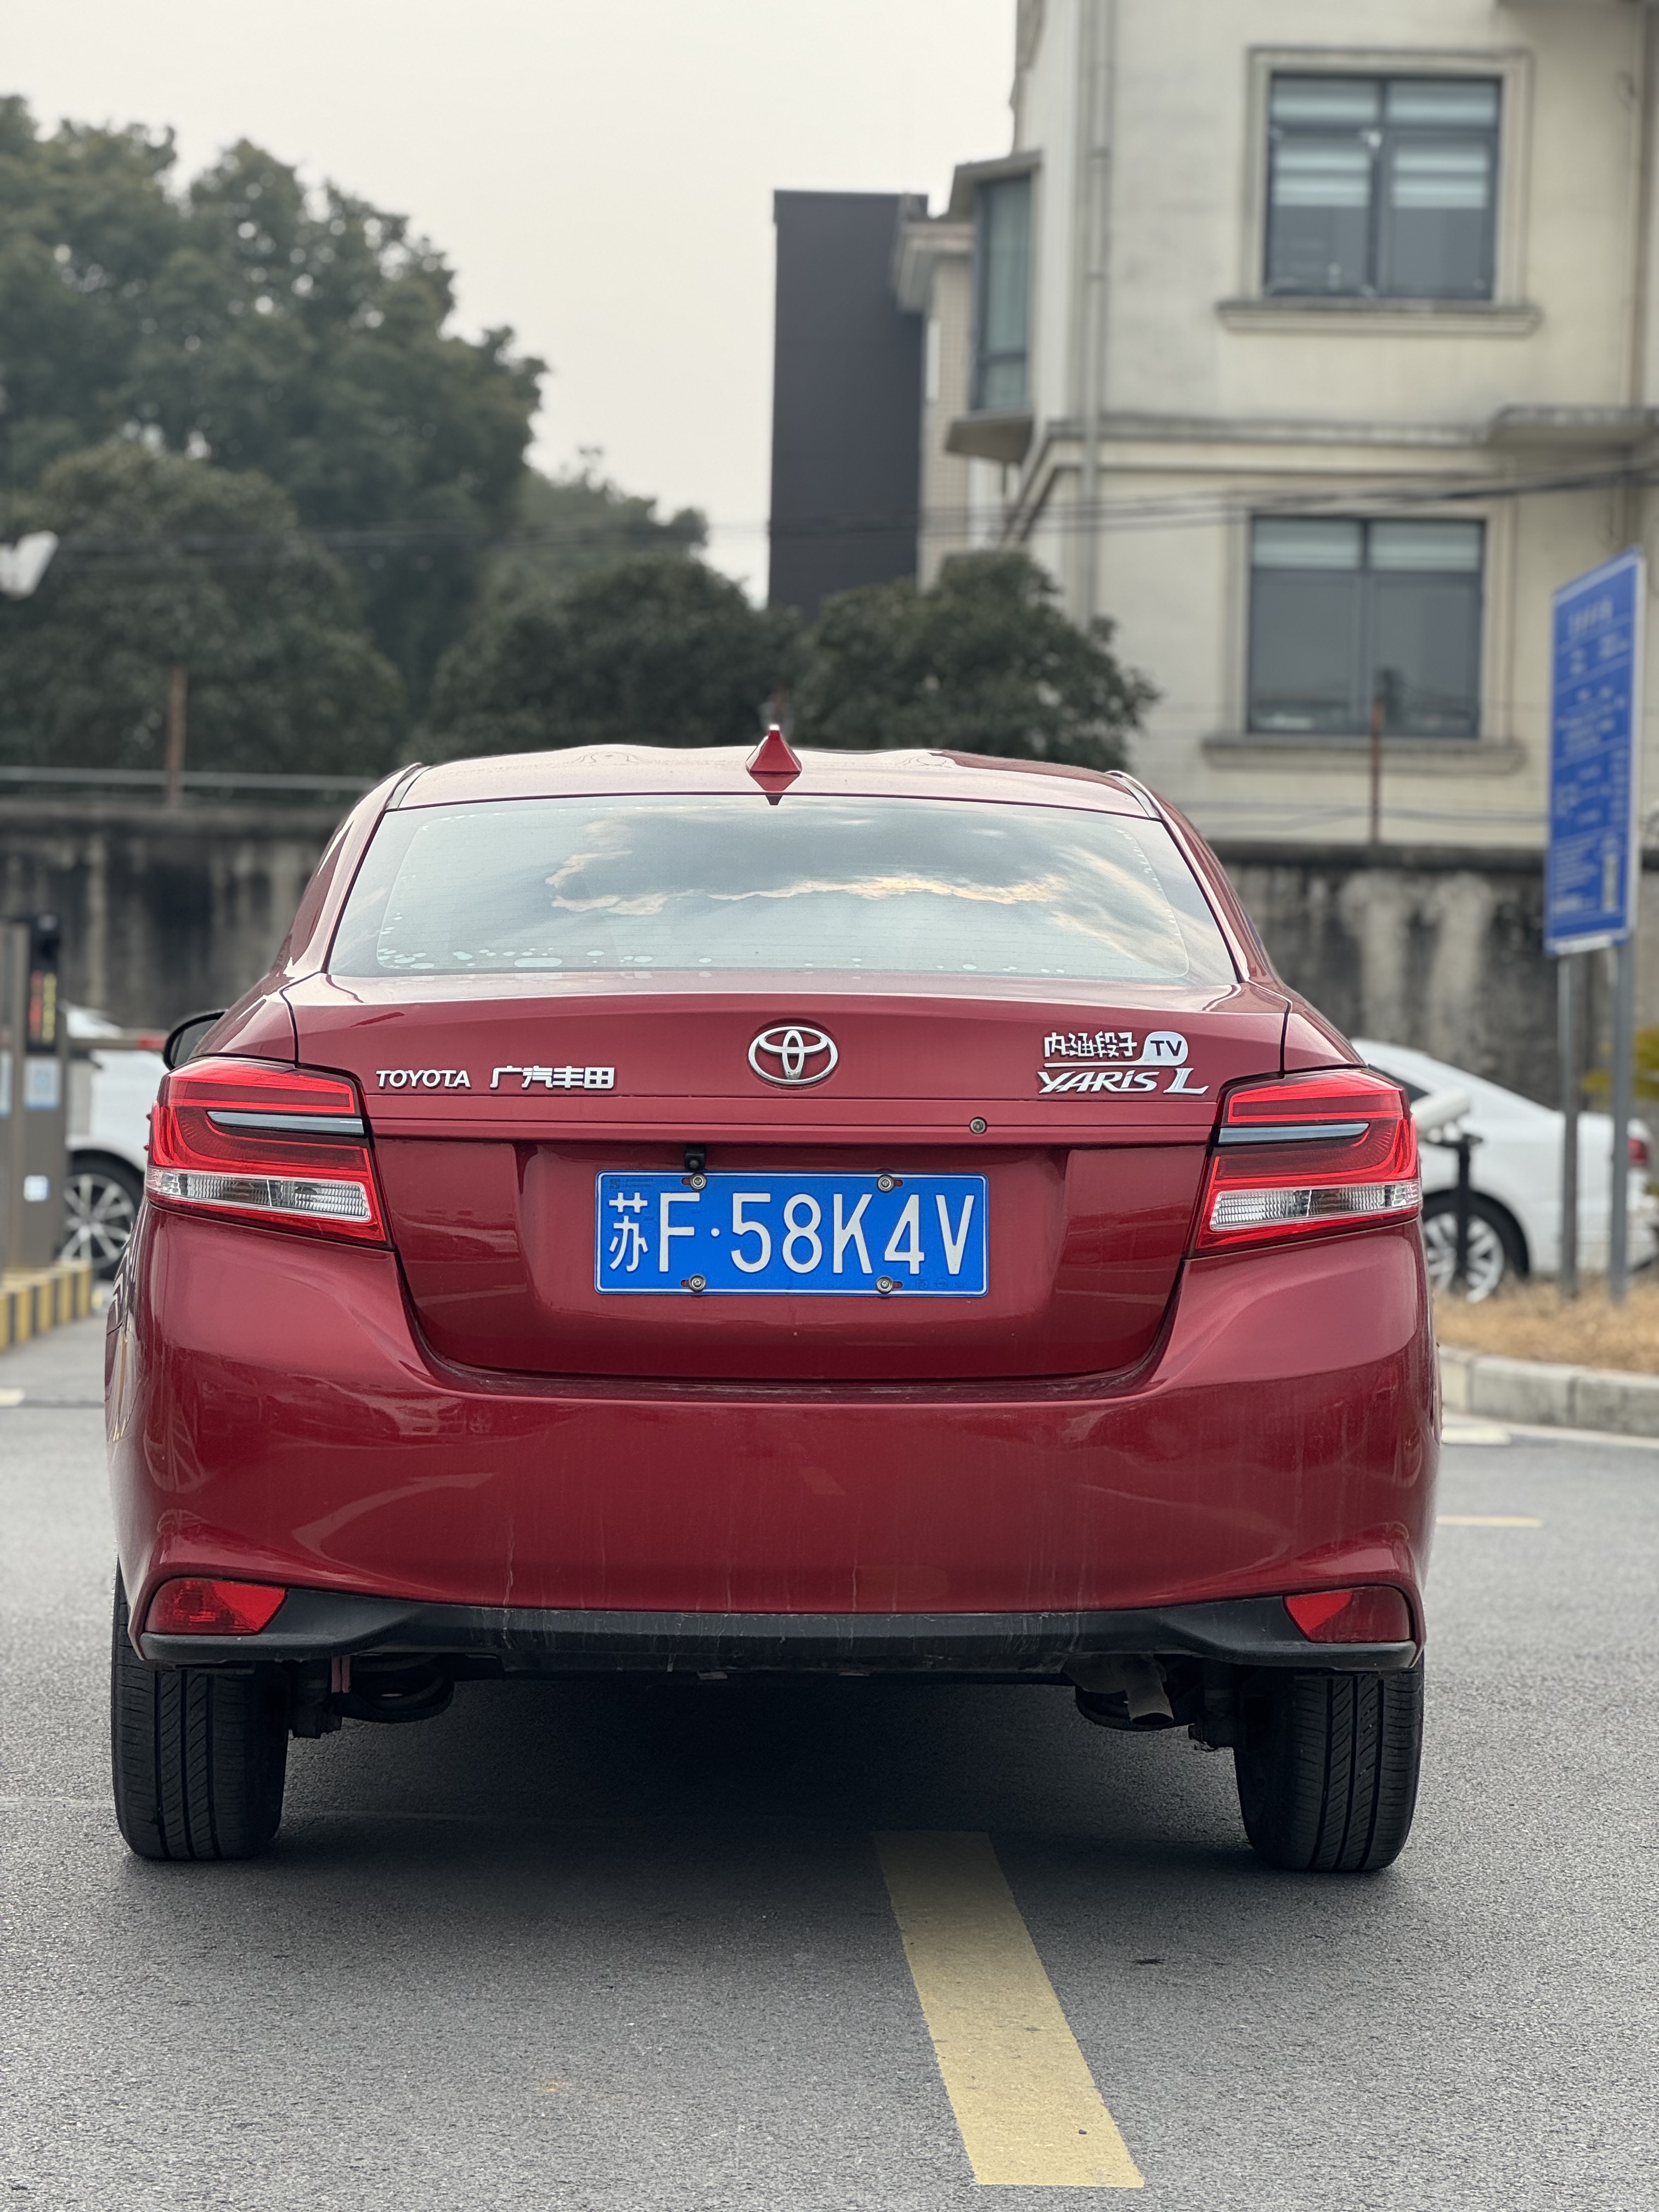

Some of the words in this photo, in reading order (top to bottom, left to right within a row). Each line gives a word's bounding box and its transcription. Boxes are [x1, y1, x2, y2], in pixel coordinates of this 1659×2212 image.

[1044, 1031, 1137, 1058] 内涵段子
[1150, 1040, 1182, 1057] TV
[376, 1069, 471, 1089] TOYOTA
[489, 1065, 615, 1090] 广汽丰田
[1163, 1068, 1209, 1095] L
